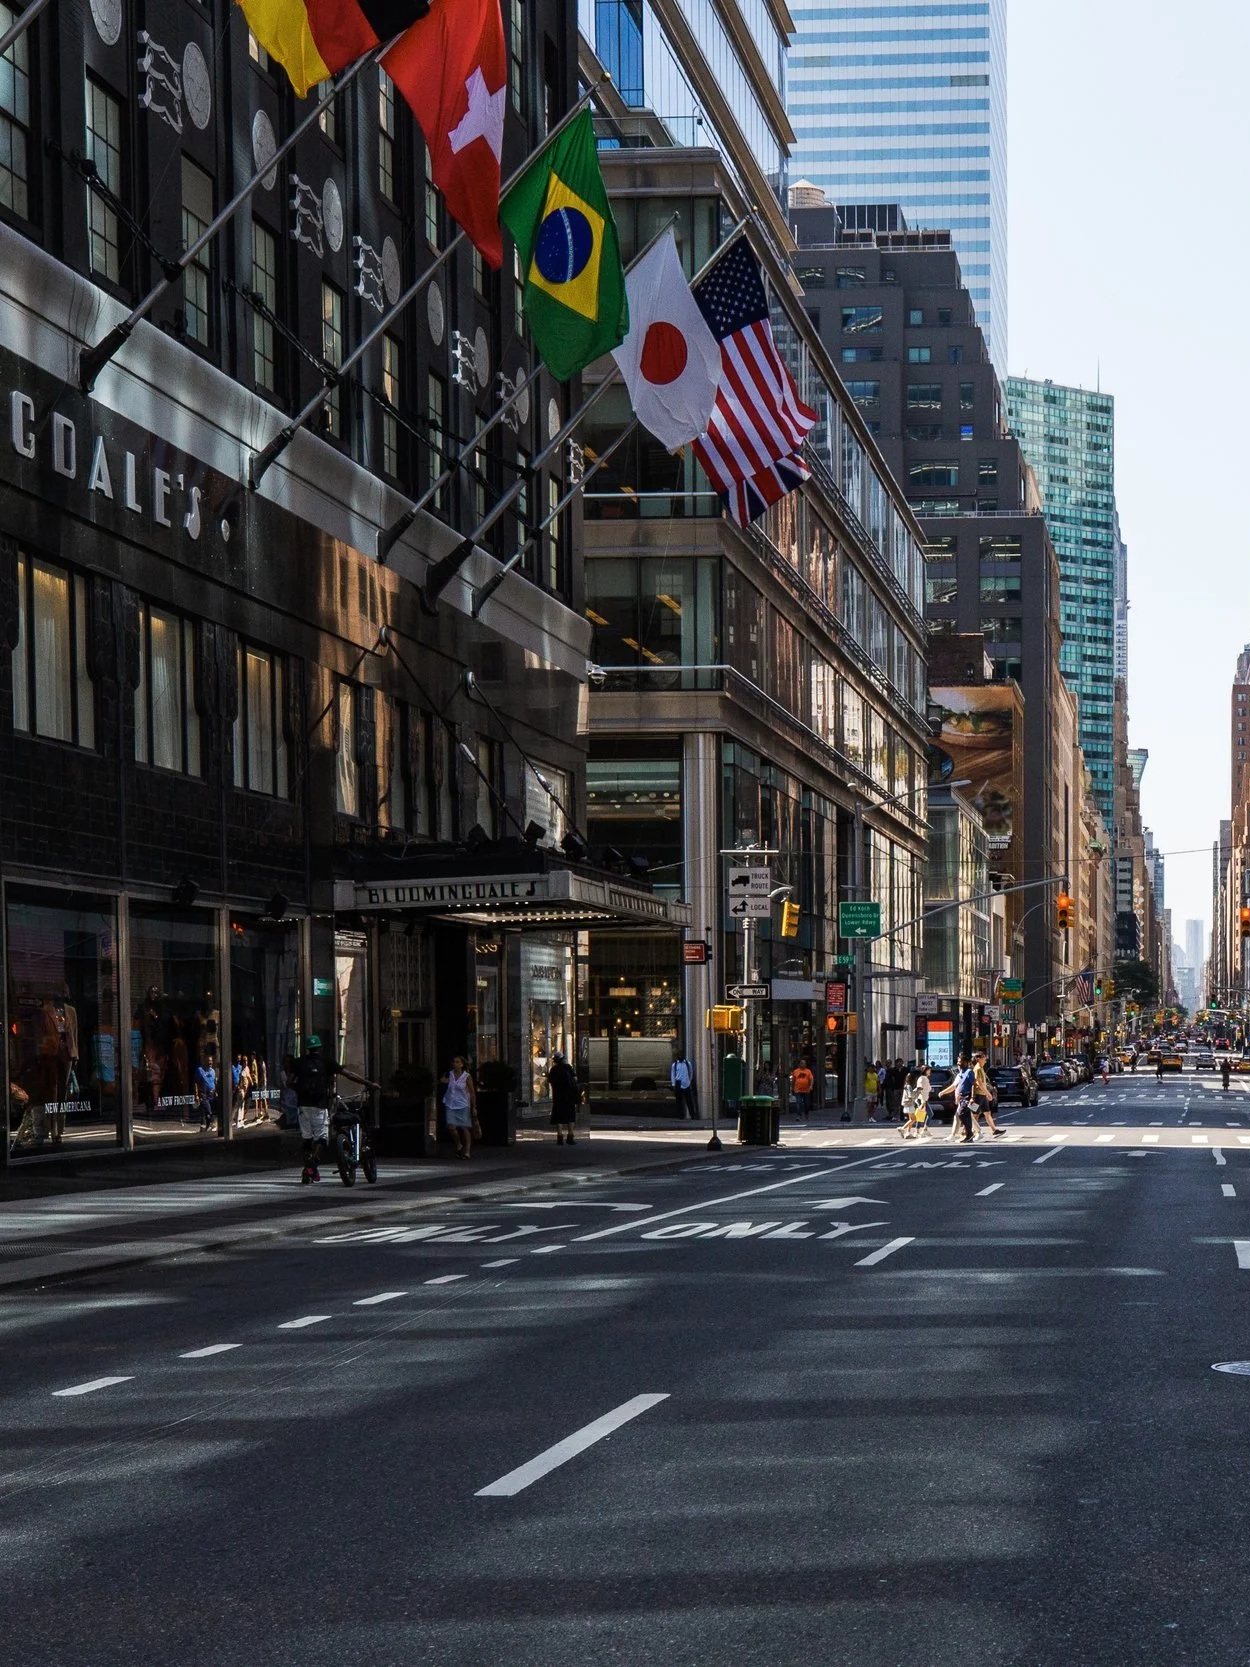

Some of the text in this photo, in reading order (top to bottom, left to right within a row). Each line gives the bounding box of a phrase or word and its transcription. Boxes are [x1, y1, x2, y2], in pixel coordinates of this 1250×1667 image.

[751, 882, 769, 890] ROUTE
[752, 987, 765, 995] WAY
[162, 1096, 174, 1106] NEW
[45, 1101, 92, 1114] NEW AMERICANA
[680, 1163, 821, 1172] ONLY
[869, 1161, 1007, 1169] ONLY
[312, 1224, 581, 1243] ONLY
[640, 1221, 892, 1240] ONLY
